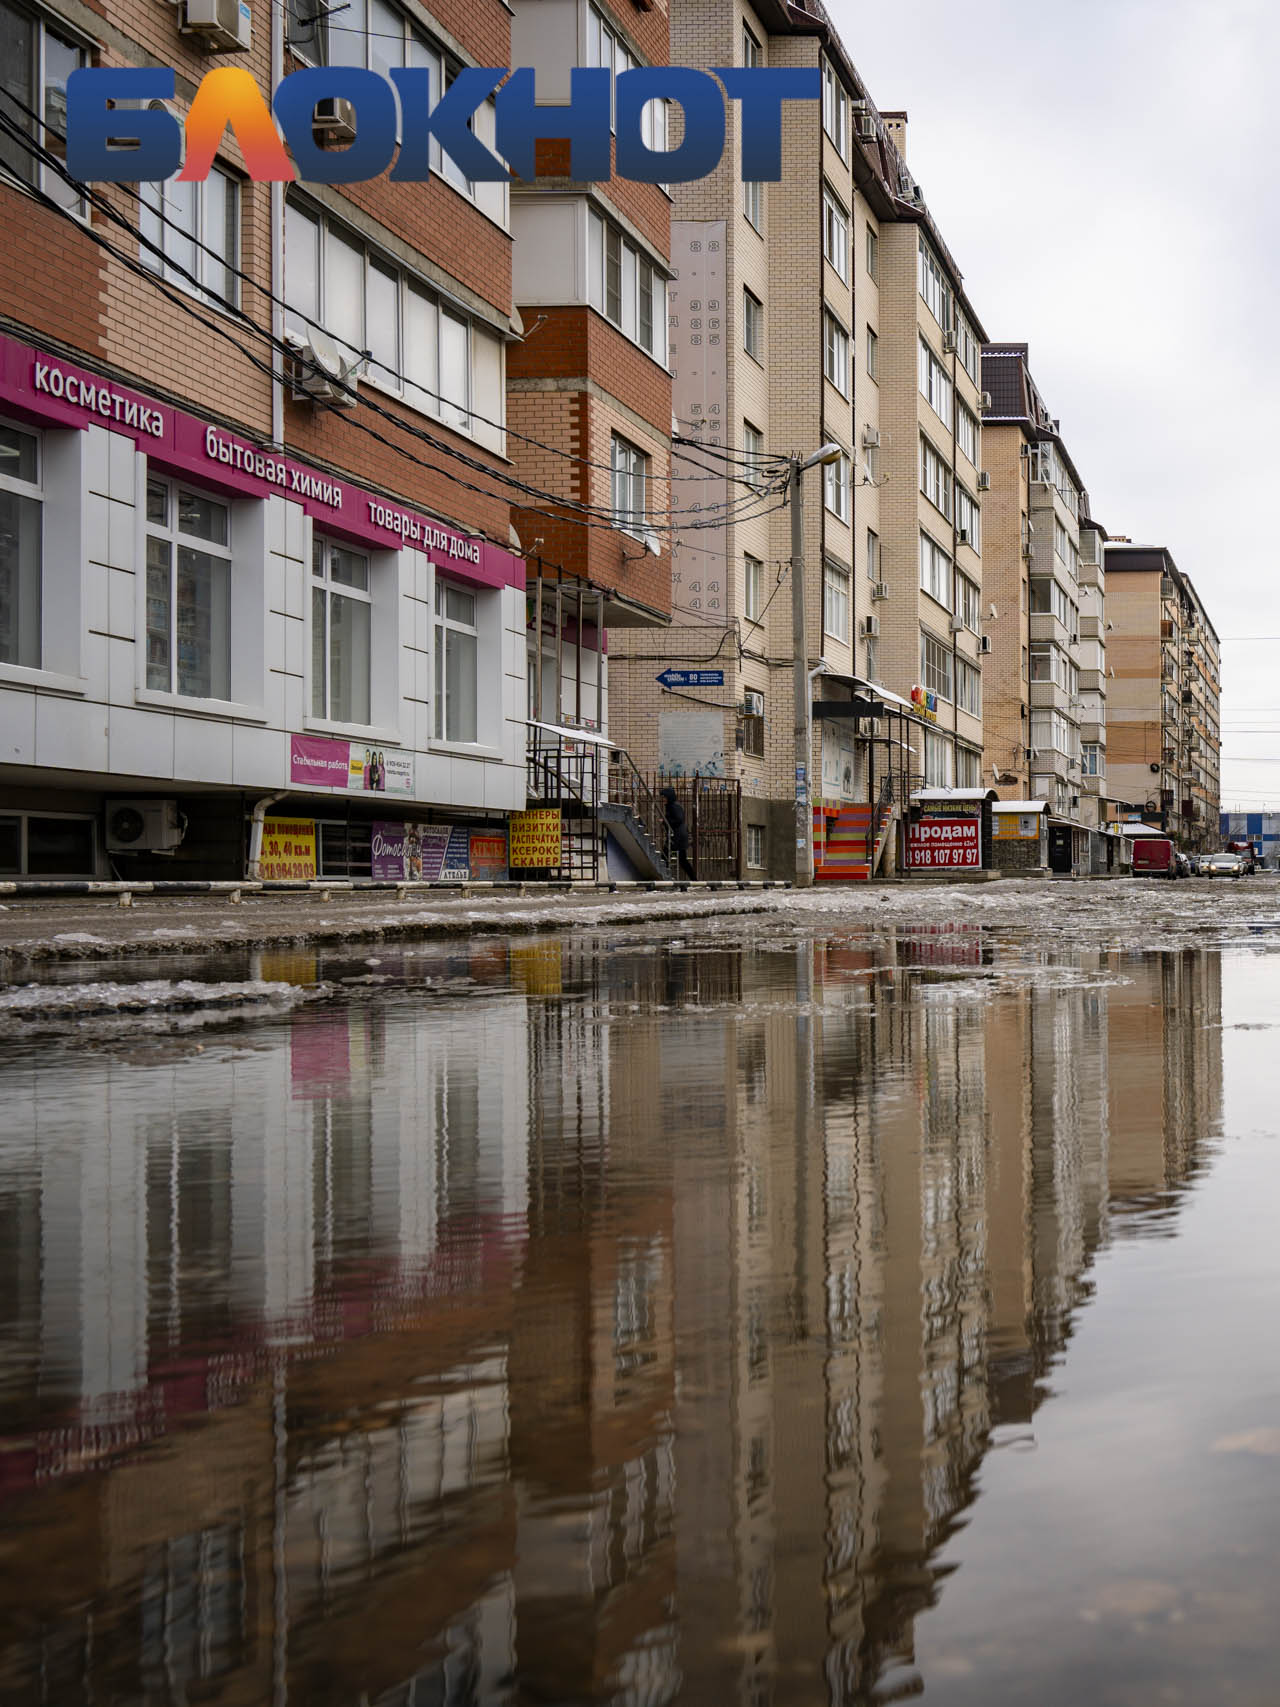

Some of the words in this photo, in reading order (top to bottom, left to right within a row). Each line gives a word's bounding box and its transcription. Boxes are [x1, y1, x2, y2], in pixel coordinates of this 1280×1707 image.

[35, 361, 164, 438] косметика
[205, 425, 286, 487] бытовая
[291, 468, 342, 509] химия
[368, 501, 420, 541] товары
[423, 525, 448, 551] для
[449, 535, 480, 564] дома
[292, 754, 327, 768] Стабильная
[327, 758, 349, 770] работа
[511, 810, 560, 820] БАННЕРЫ
[511, 822, 559, 832] ВИЗИТКИ
[909, 823, 976, 842] Продам
[511, 833, 560, 844] РАСПЕЧАТКА
[511, 845, 560, 856] КСЕРОКС
[914, 849, 932, 865] 918
[933, 848, 951, 864] 107
[952, 848, 964, 864] 97
[965, 848, 978, 864] 97
[512, 856, 559, 867] СКАНЕР
